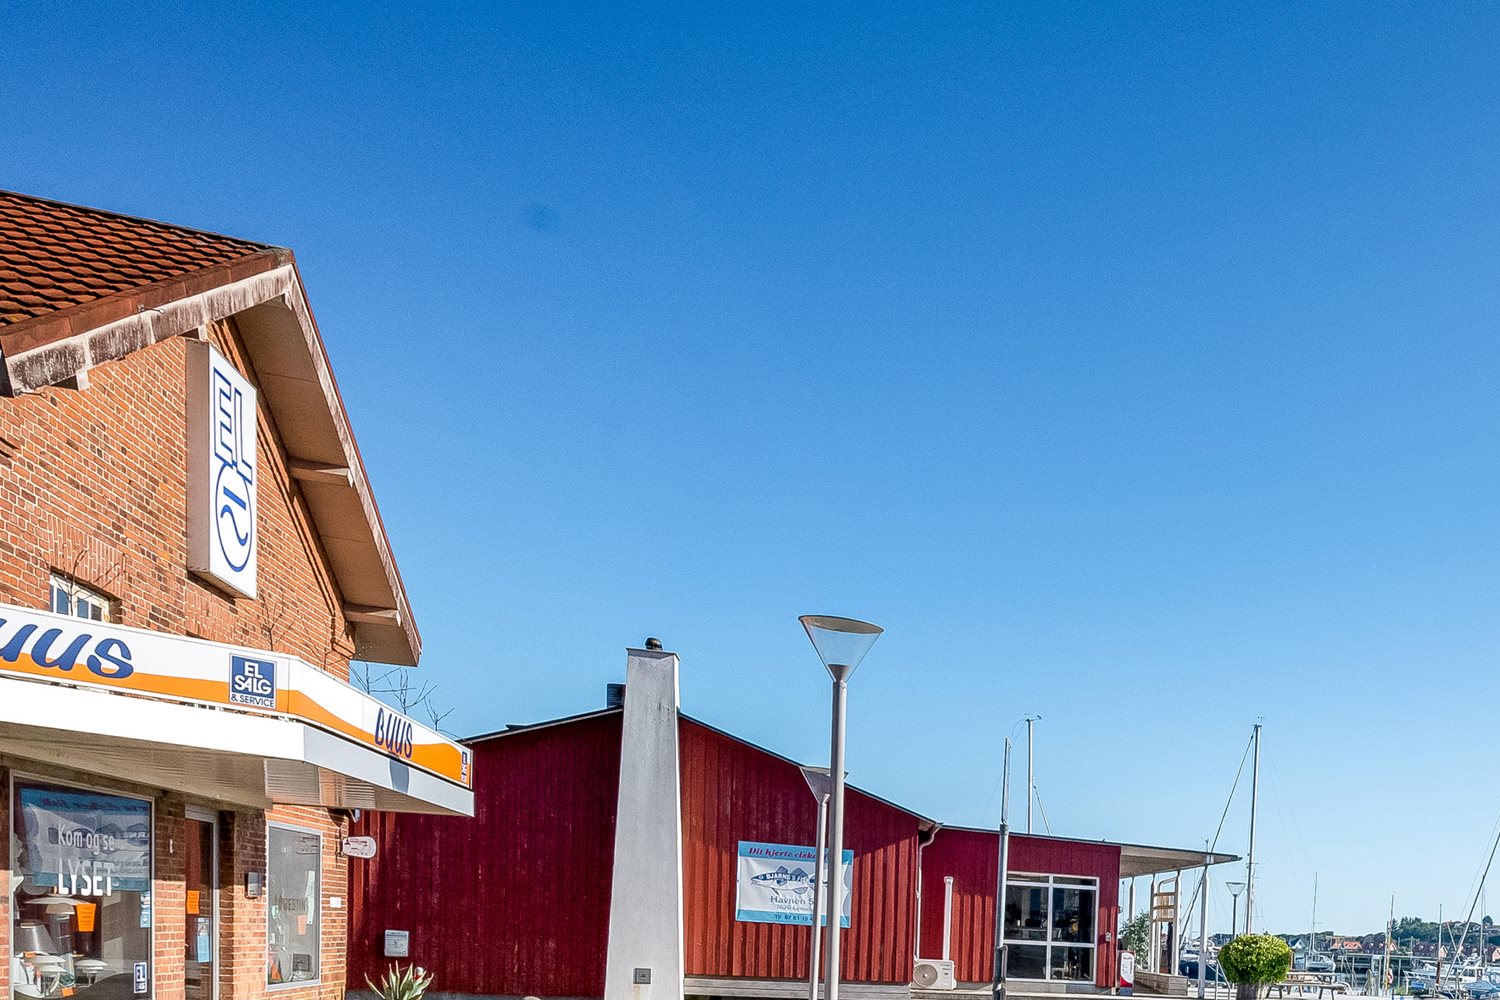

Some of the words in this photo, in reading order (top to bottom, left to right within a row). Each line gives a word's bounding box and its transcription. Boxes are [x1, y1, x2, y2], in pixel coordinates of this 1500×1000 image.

[244, 661, 264, 679] EL
[233, 674, 272, 695] SALG
[231, 693, 238, 702] &
[239, 694, 275, 708] SERVICE
[58, 824, 82, 848] Kom
[86, 833, 99, 855] og
[102, 834, 115, 851] se
[749, 847, 763, 855] Dit
[765, 848, 793, 857] hjerte
[58, 858, 115, 897] LYSET
[770, 896, 806, 905] Havnen
